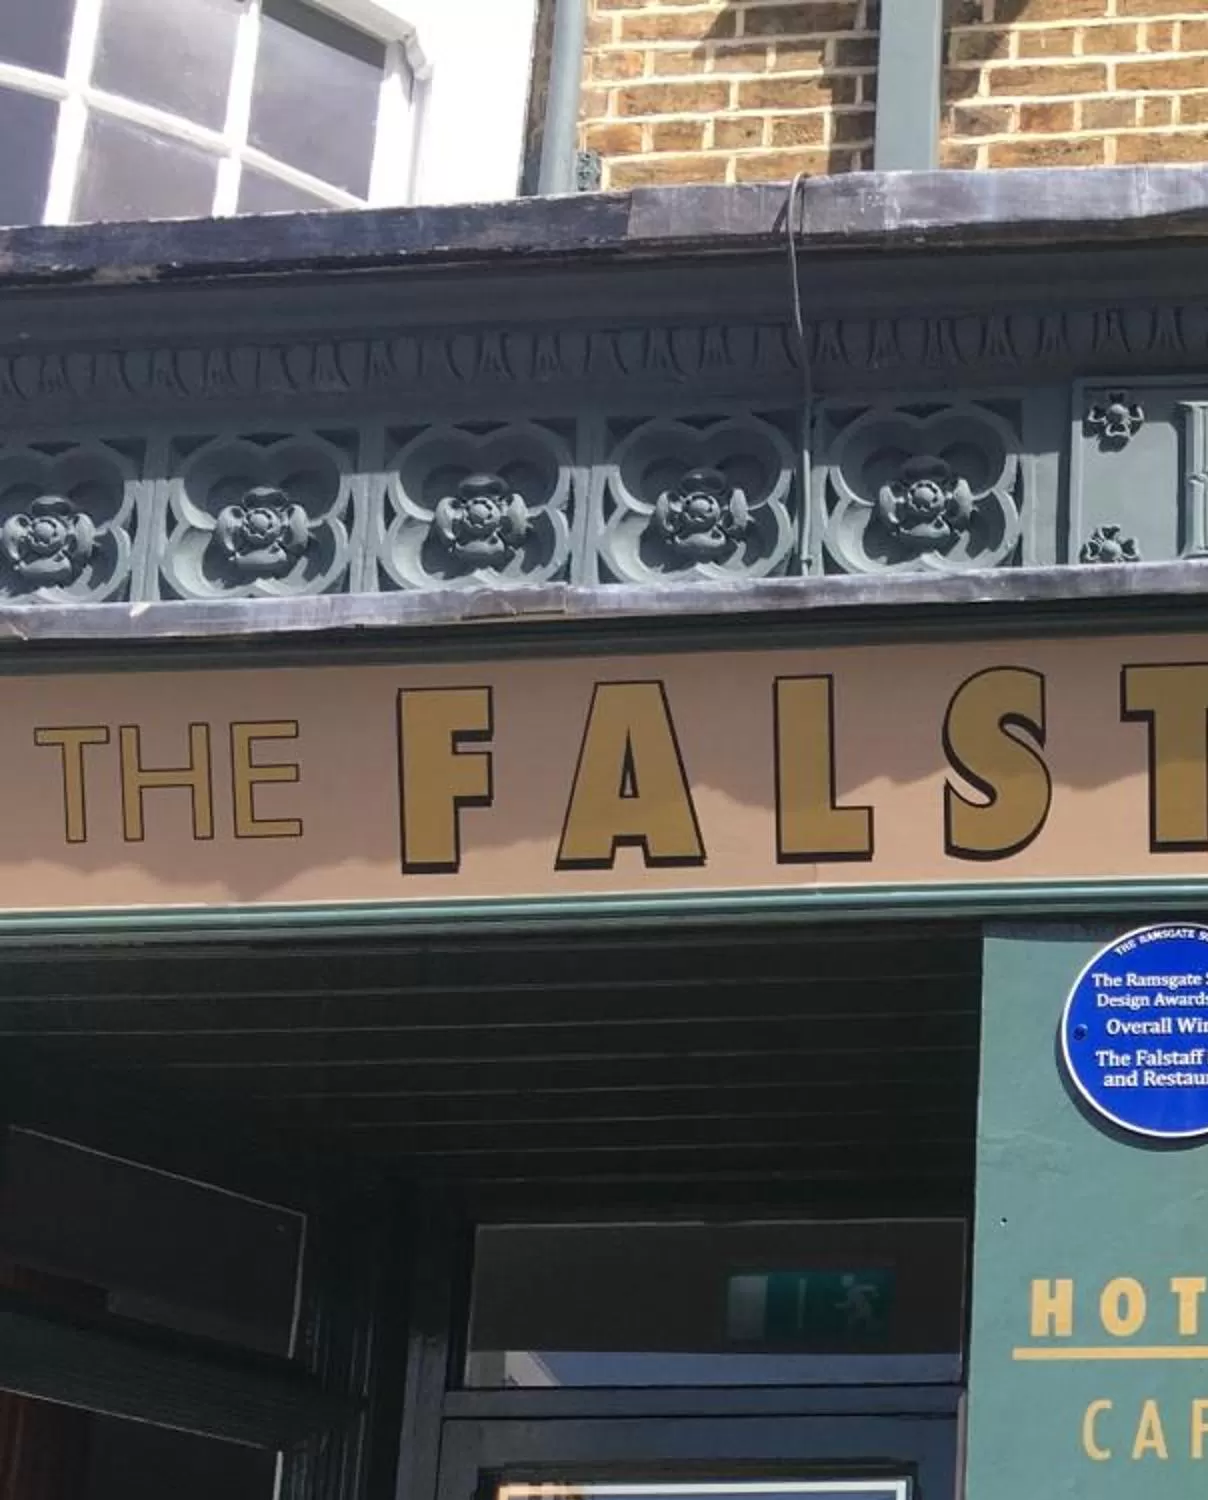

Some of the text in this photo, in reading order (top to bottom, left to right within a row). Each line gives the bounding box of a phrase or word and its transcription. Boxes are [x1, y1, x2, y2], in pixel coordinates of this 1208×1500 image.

[33, 719, 303, 844] THE
[1114, 939, 1137, 956] THE
[1139, 928, 1196, 944] RAMSGATE
[1092, 973, 1122, 987] The
[1126, 972, 1202, 990] Ramsgate
[1097, 993, 1151, 1010] Design
[1106, 1018, 1172, 1035] Overall
[1095, 1050, 1131, 1067] The
[1136, 1048, 1204, 1066] Falstaff
[1104, 1070, 1138, 1087] and
